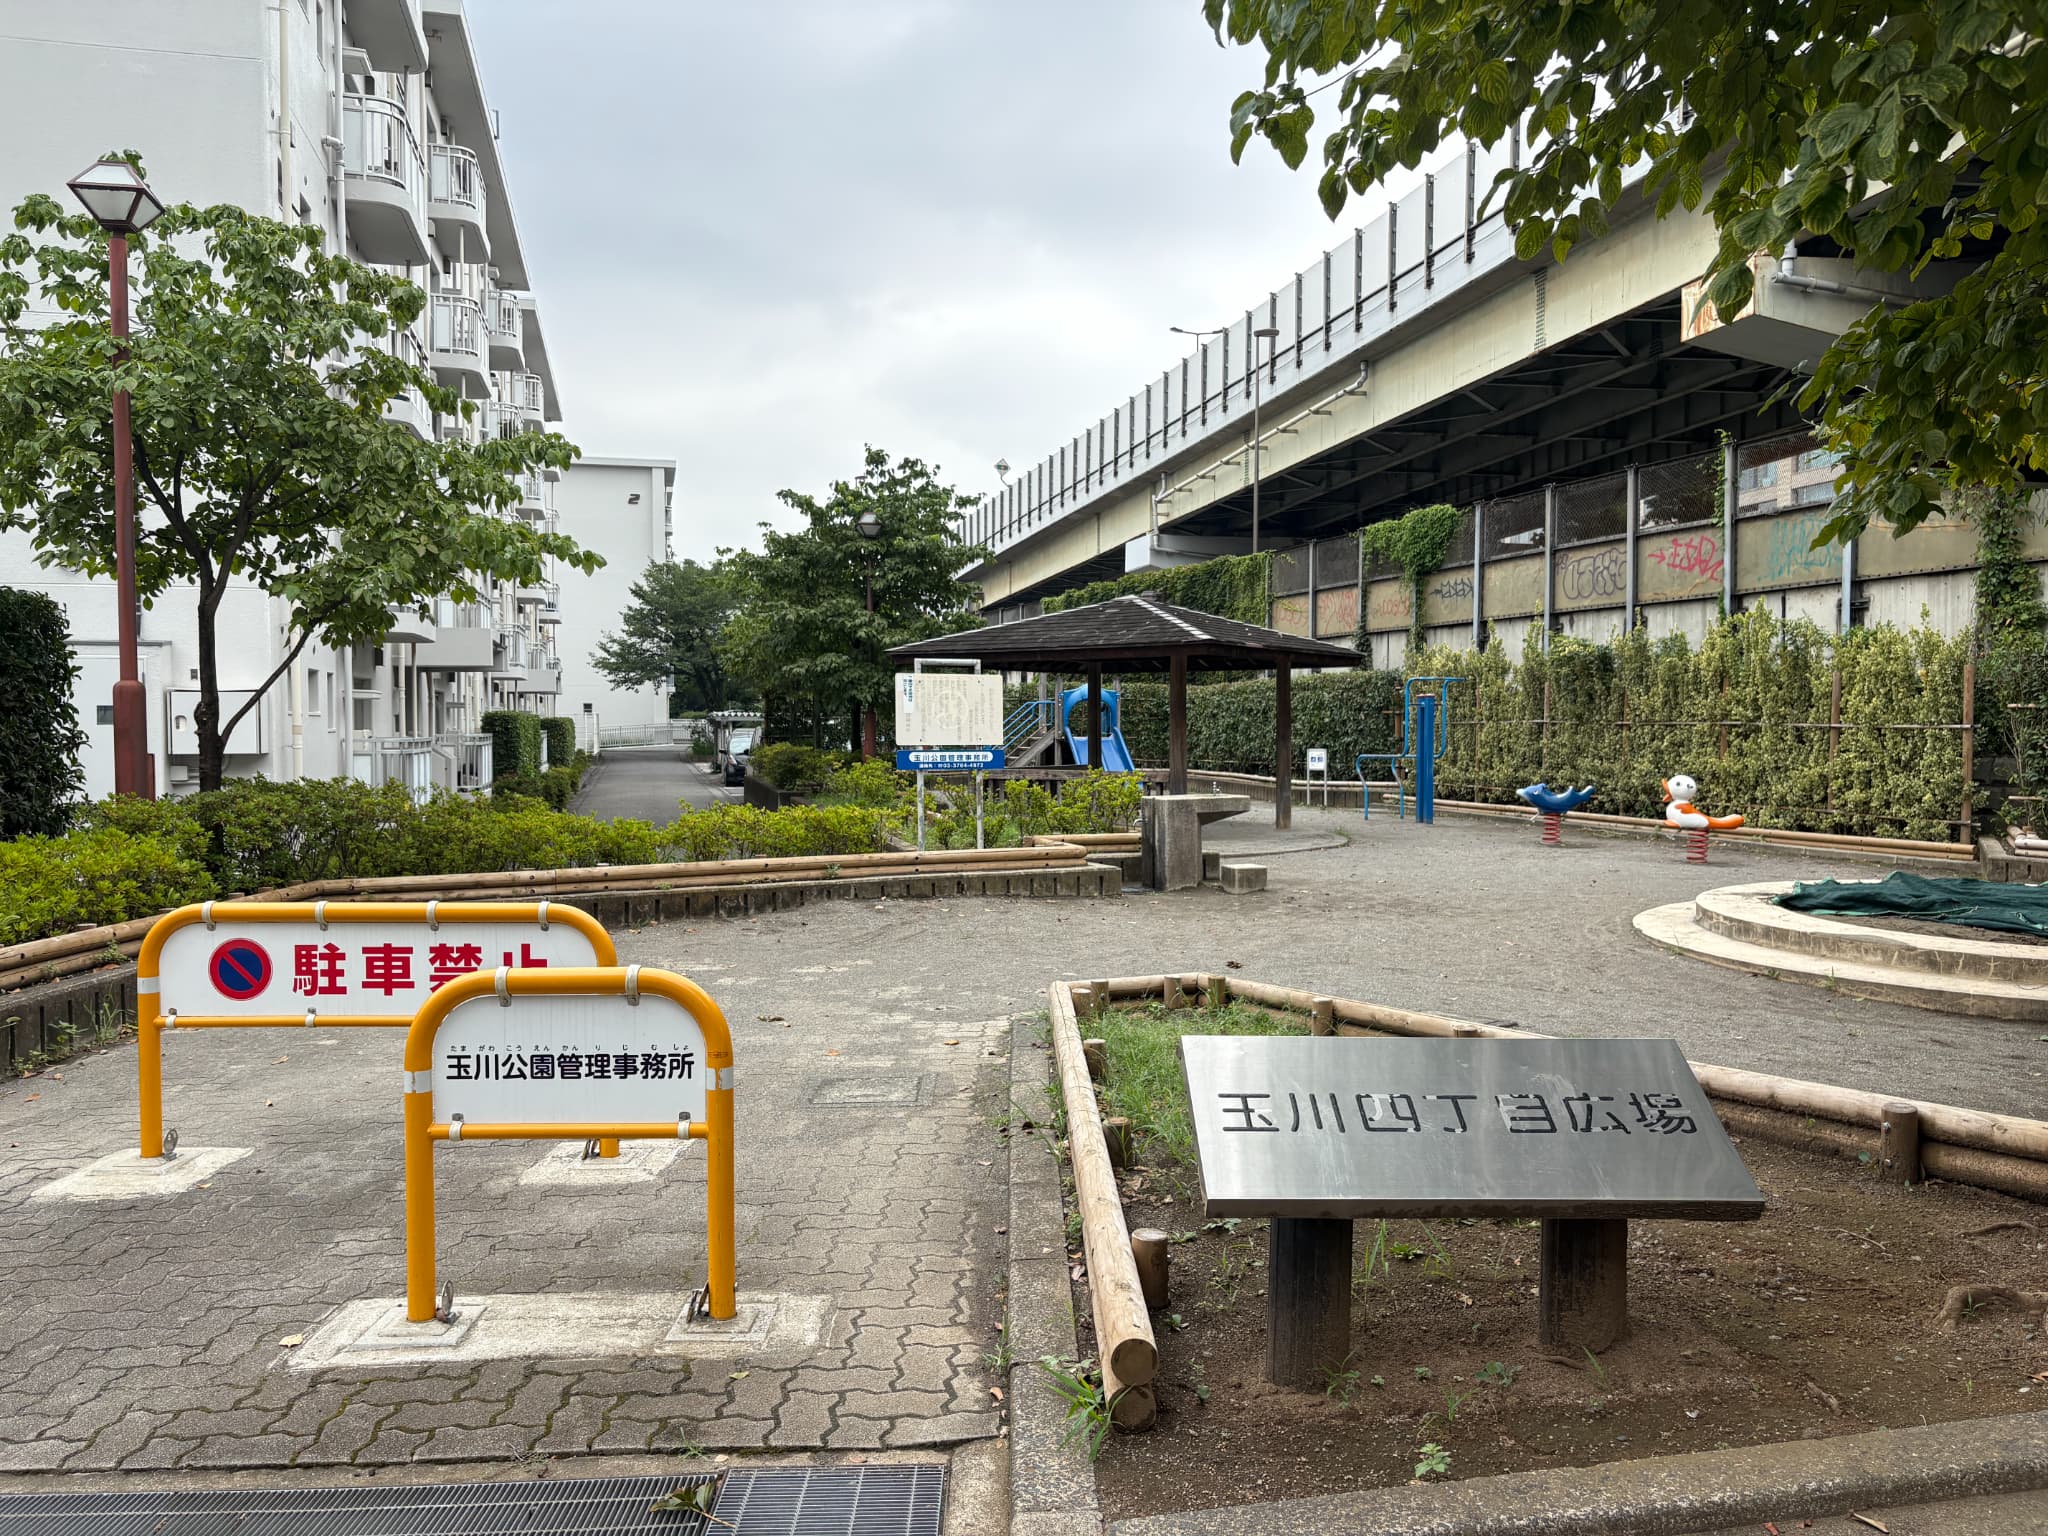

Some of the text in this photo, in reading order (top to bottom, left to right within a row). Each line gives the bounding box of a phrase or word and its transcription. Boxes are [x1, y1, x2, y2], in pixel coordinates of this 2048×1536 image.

[627, 493, 641, 504] 2
[446, 1053, 695, 1081] 玉川公園管理事務所
[1217, 1092, 1698, 1136] 玉川四丁目広場
